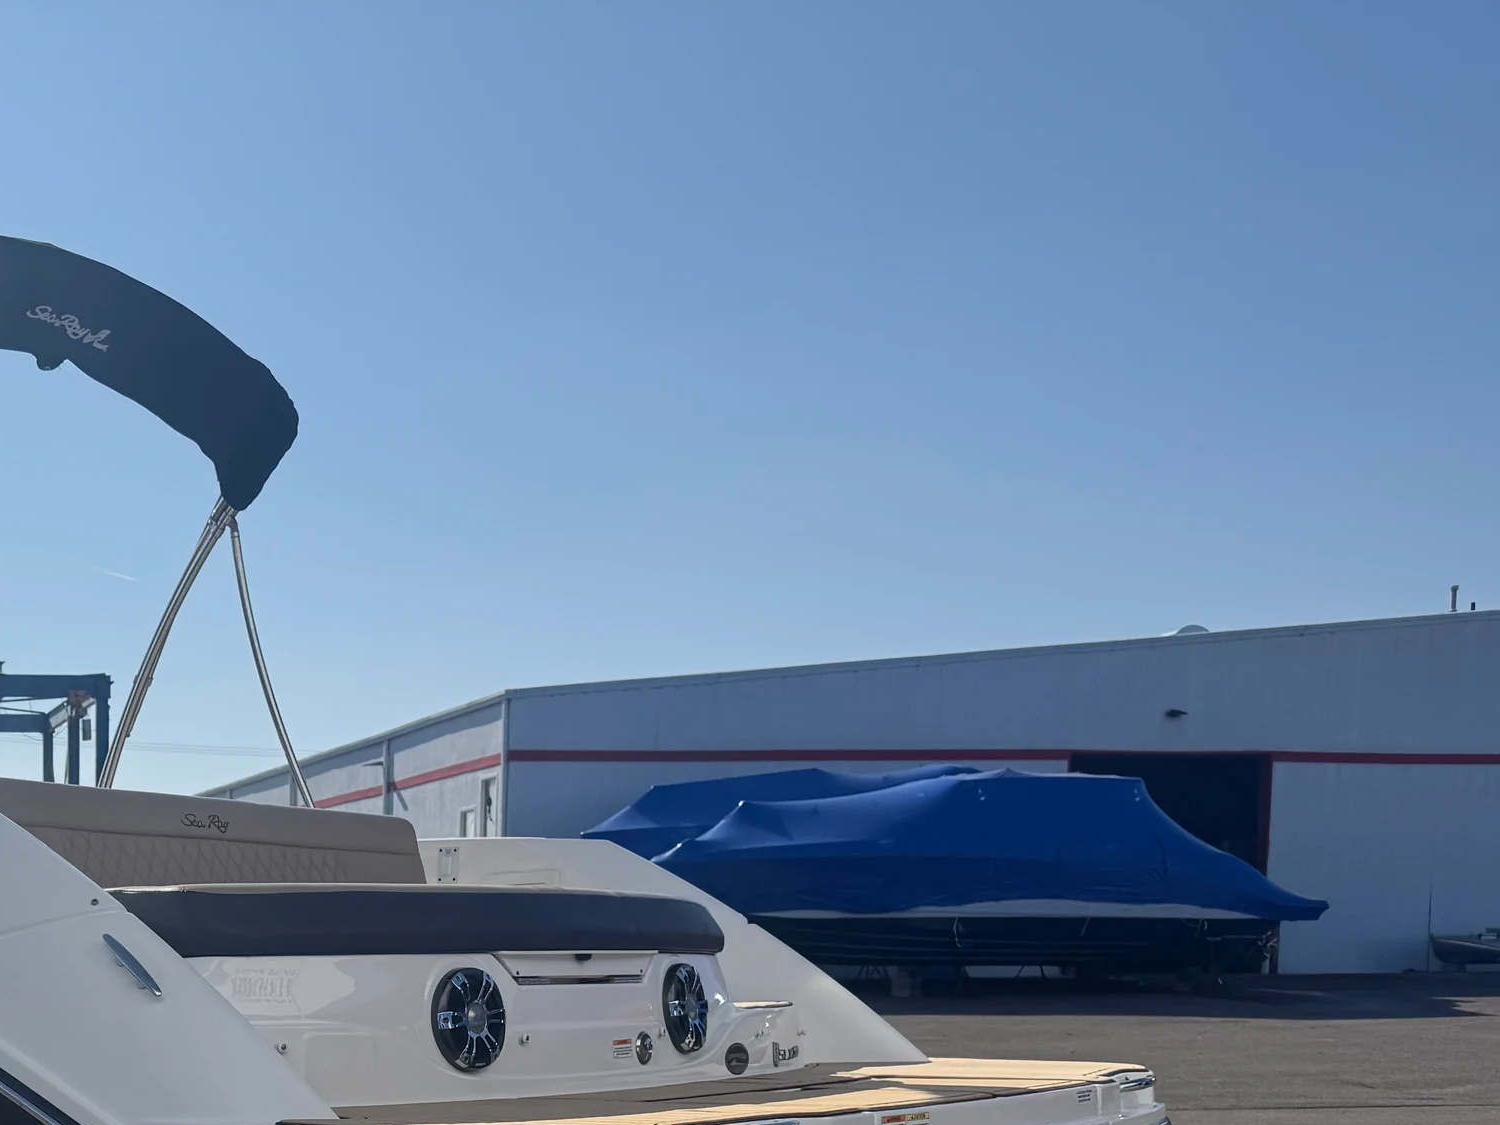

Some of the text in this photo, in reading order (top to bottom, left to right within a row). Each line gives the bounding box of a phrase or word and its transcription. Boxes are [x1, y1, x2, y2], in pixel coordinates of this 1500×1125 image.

[26, 305, 90, 340] Sea Ray
[181, 813, 229, 834] Sea Ray
